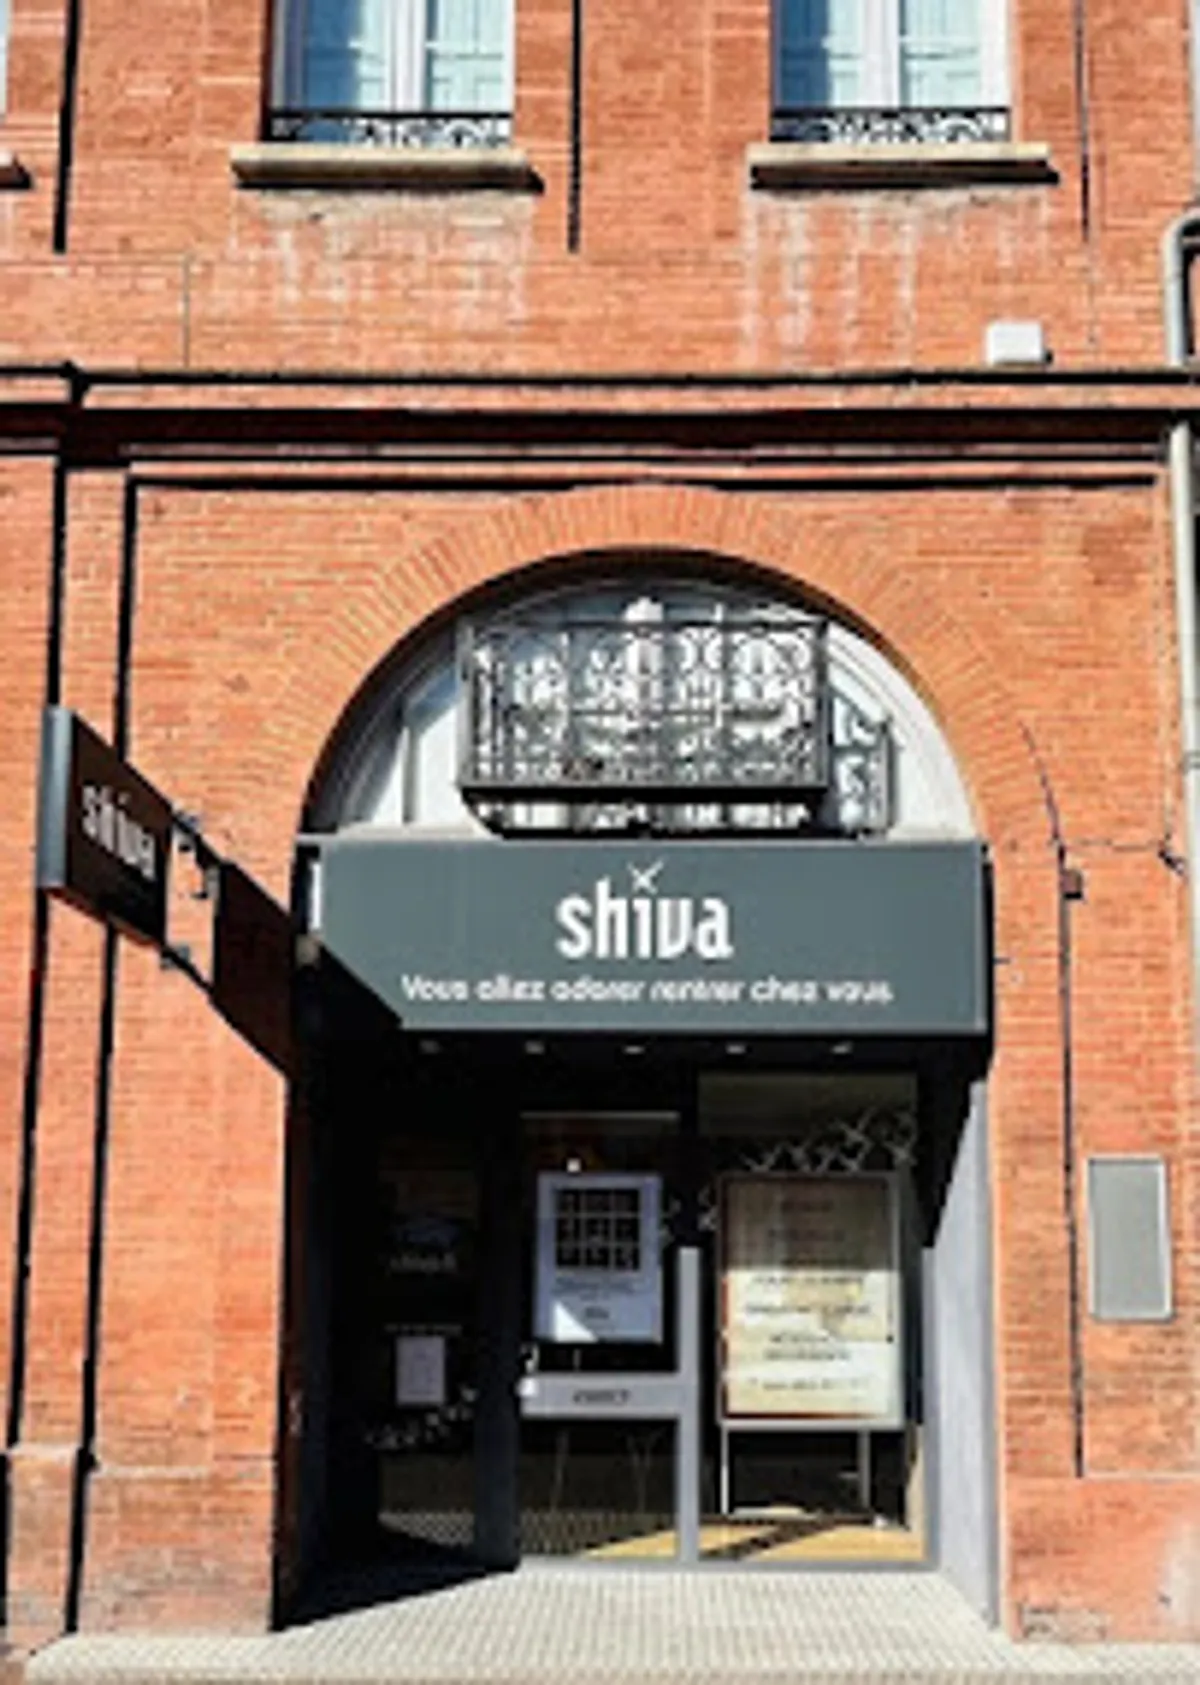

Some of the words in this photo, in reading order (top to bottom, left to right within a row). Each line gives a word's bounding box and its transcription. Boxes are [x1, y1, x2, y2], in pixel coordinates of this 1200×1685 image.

[82, 784, 156, 882] shiva
[556, 862, 734, 959] shiva
[401, 974, 468, 1001] Vous
[476, 974, 545, 1001] allez
[550, 975, 645, 1001] adorer
[650, 978, 745, 1002] rentrer
[750, 975, 817, 1002] chez
[827, 980, 893, 1002] vous
